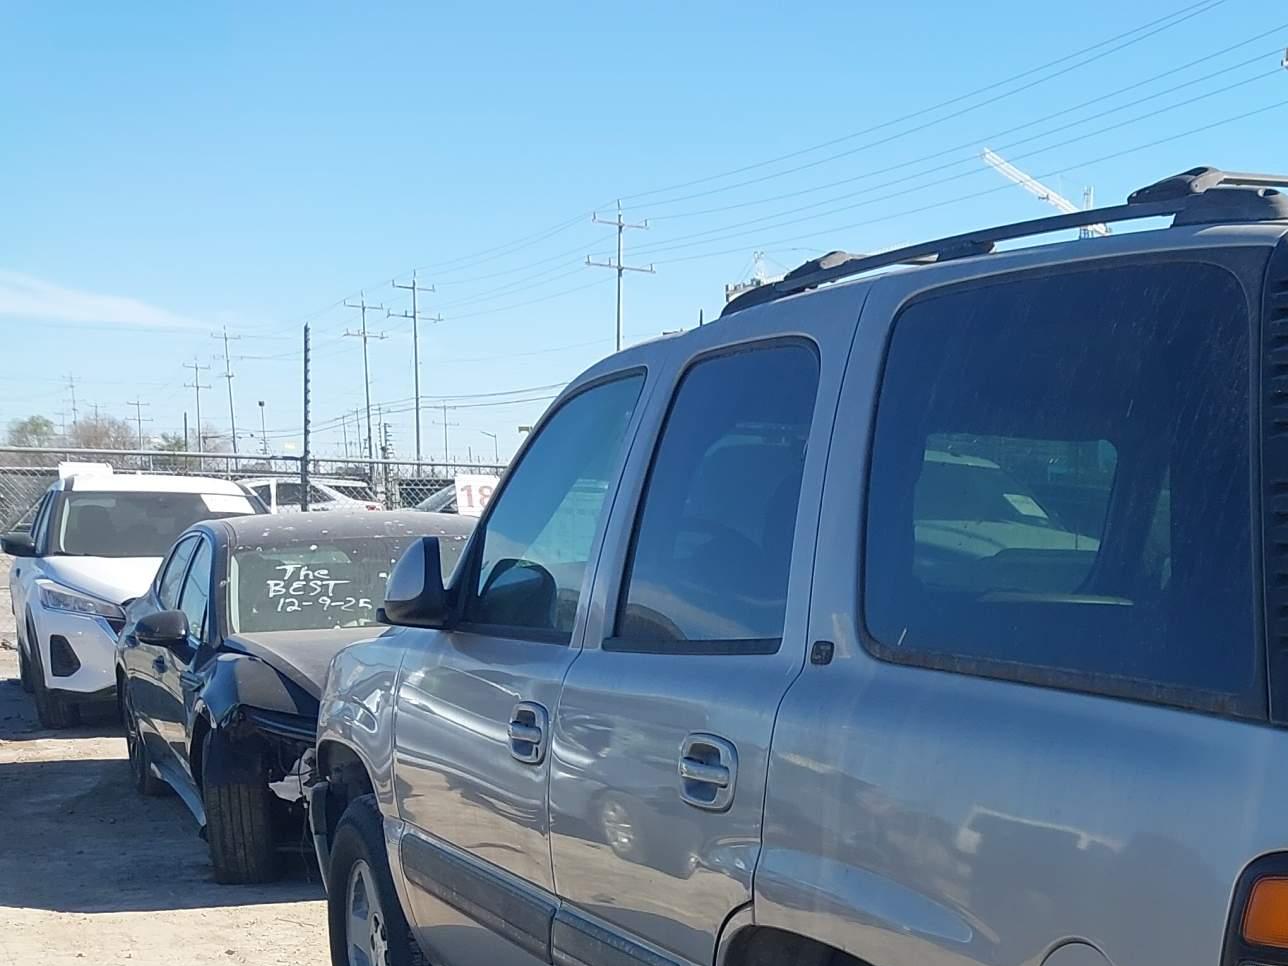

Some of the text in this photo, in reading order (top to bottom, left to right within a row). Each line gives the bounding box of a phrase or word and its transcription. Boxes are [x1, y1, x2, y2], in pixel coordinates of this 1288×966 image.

[275, 565, 331, 580] The
[266, 580, 351, 597] BEST
[277, 597, 373, 612] 12-9-25
